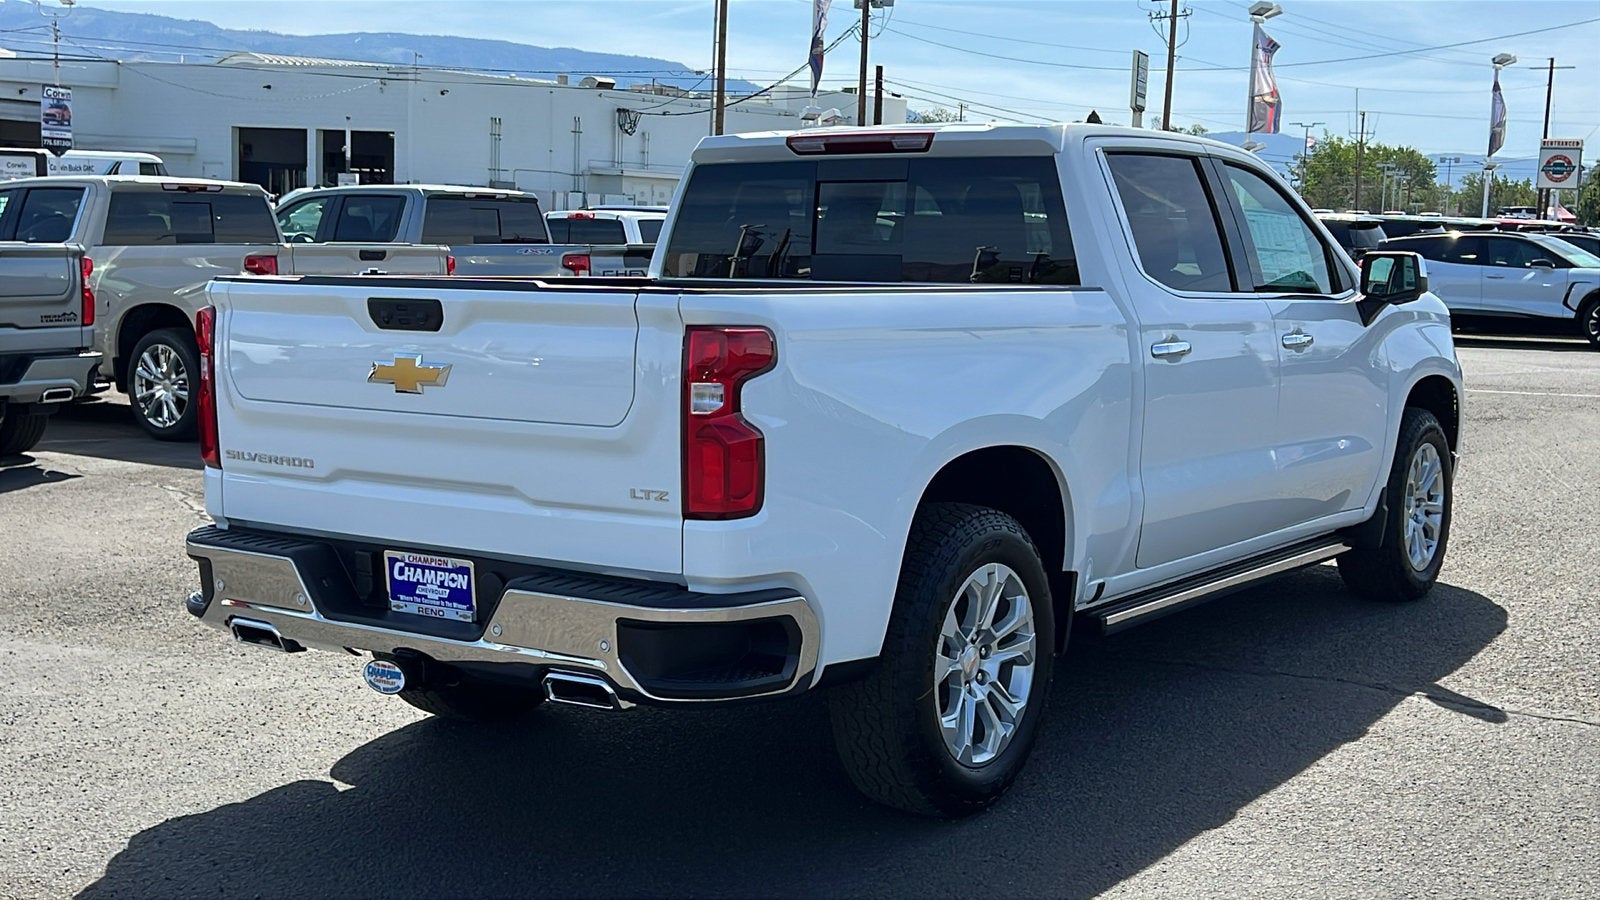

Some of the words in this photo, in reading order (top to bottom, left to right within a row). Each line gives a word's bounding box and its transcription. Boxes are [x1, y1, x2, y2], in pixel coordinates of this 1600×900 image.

[46, 88, 71, 98] Corwin
[69, 164, 82, 172] Buick
[225, 449, 314, 468] SILVERADO
[630, 488, 669, 502] LTZ
[408, 555, 448, 567] CHAMPION
[393, 562, 468, 590] CHAMPION
[417, 587, 447, 597] CHEVROLET
[417, 606, 445, 617] RENO
